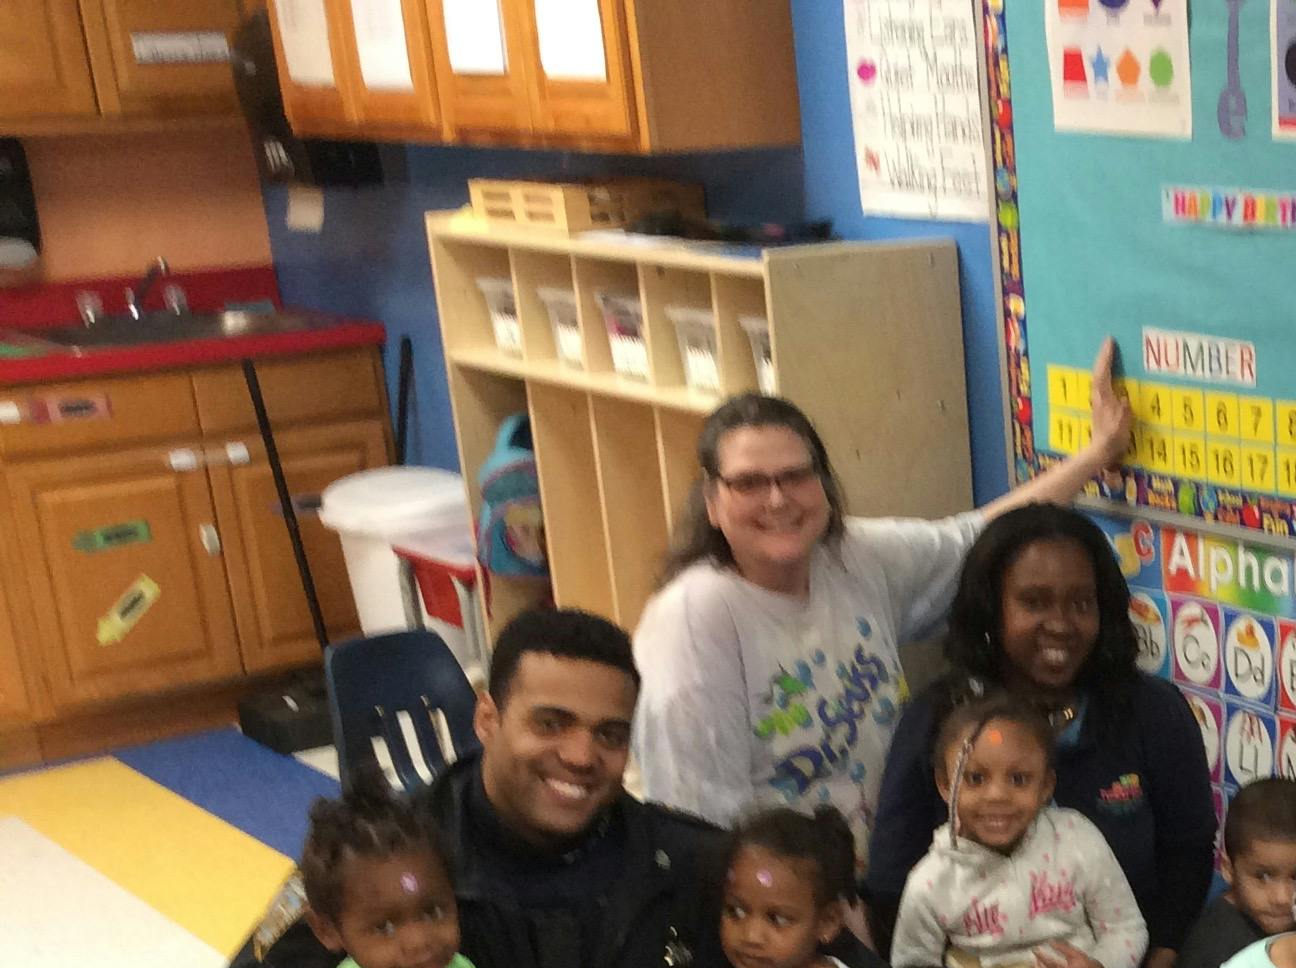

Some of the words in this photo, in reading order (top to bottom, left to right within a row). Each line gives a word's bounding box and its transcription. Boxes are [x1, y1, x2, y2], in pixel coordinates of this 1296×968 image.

[1173, 190, 1236, 221] HAPPY
[1145, 333, 1254, 381] NUMBER
[1183, 396, 1194, 426] 5
[1251, 405, 1262, 435] 7
[1181, 443, 1200, 474] 15
[1214, 449, 1233, 480] 16
[1248, 452, 1268, 483] 17
[1234, 646, 1265, 687] Dd
